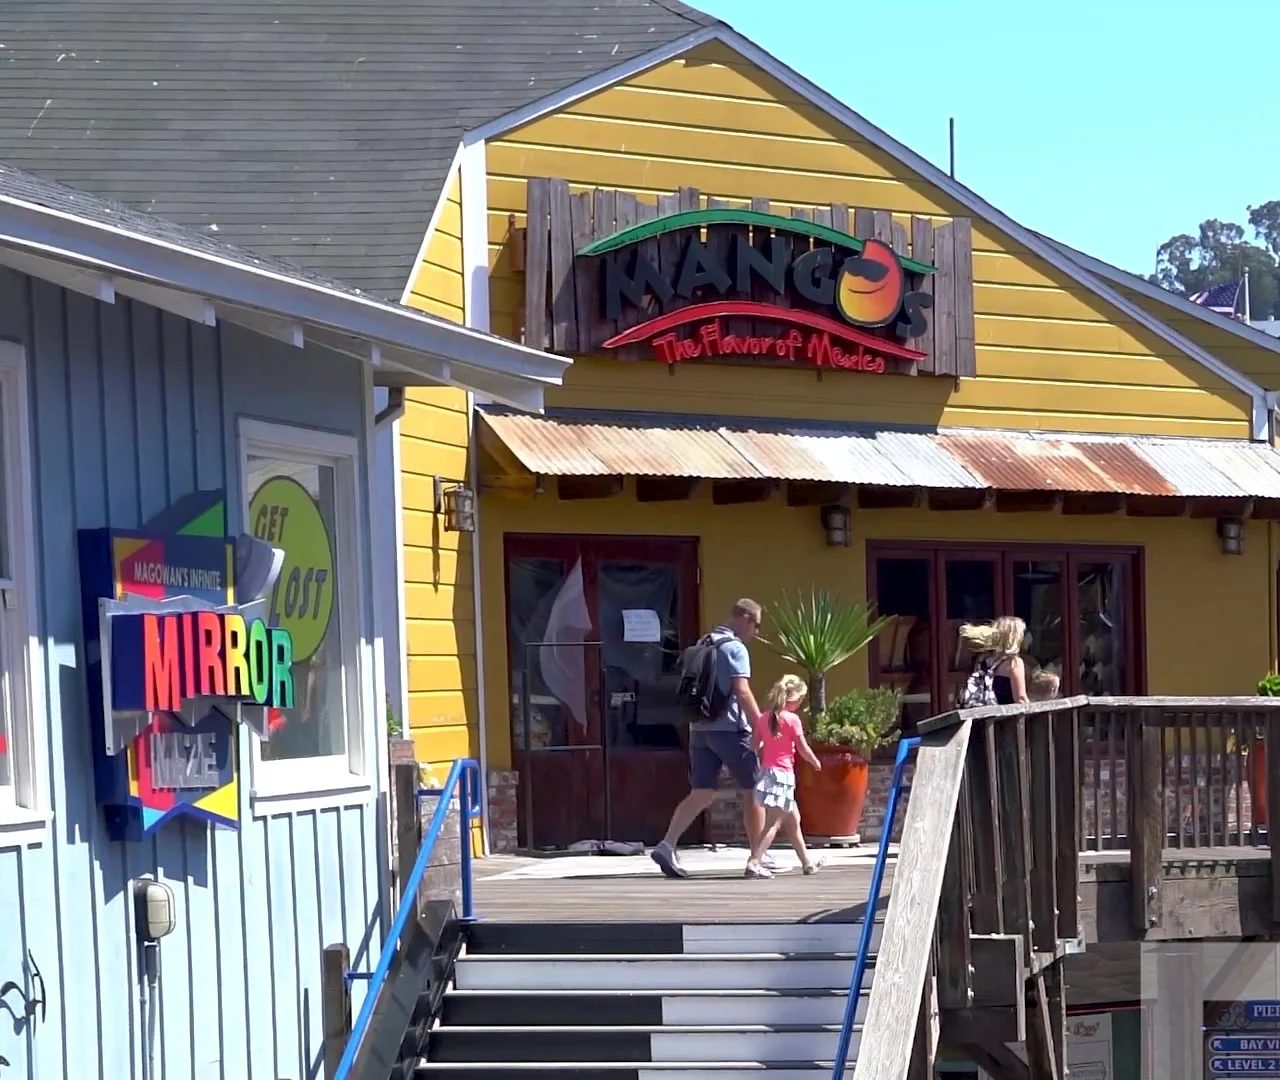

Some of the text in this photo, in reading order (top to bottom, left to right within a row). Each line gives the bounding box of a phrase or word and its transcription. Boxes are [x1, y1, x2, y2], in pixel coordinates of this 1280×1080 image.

[653, 319, 885, 373] The Flavor of Mexico
[254, 504, 288, 543] GET
[134, 562, 222, 591] MAGOWAN'S INFINITE
[269, 567, 328, 628] LOST
[143, 611, 295, 712] MIRROR
[1240, 1039, 1267, 1050] BAY
[1227, 1060, 1267, 1070] LEVEL
[1268, 1060, 1275, 1070] 2
